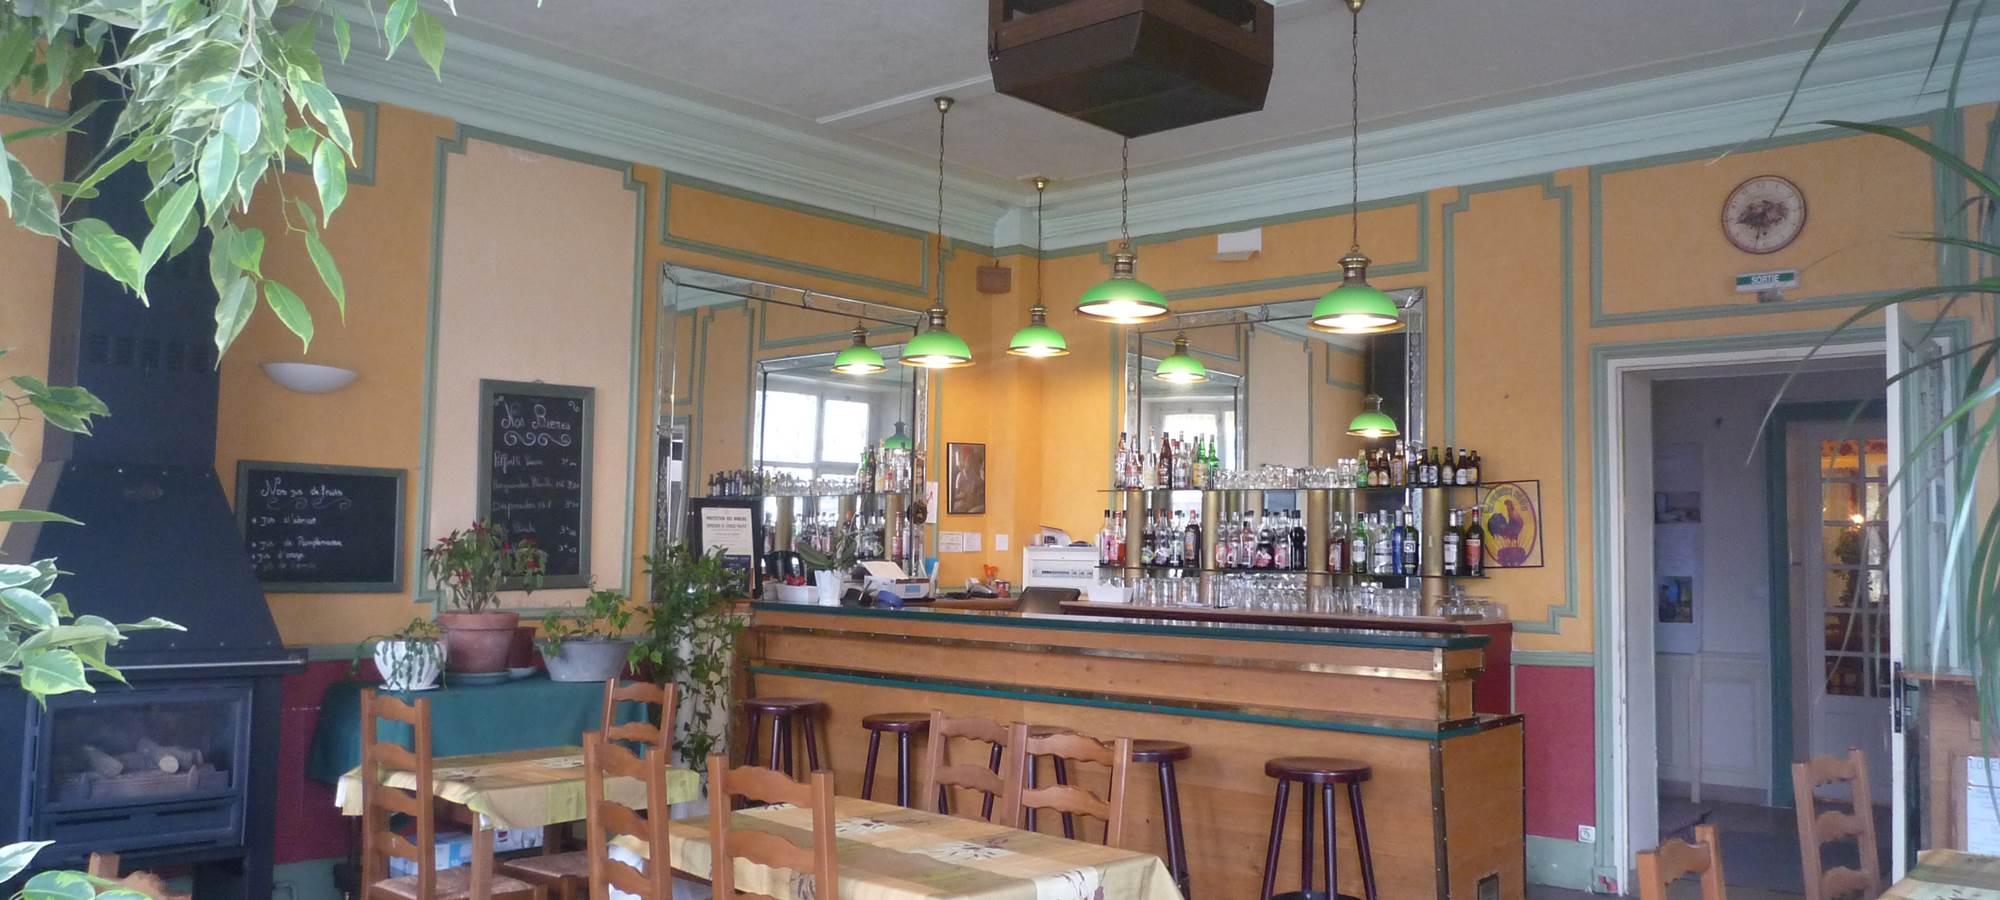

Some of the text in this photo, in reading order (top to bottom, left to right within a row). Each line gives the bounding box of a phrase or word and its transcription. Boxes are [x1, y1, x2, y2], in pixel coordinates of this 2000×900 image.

[1751, 274, 1779, 285] SORTIE
[261, 477, 287, 497] Nos
[1405, 542, 1415, 552] 51
